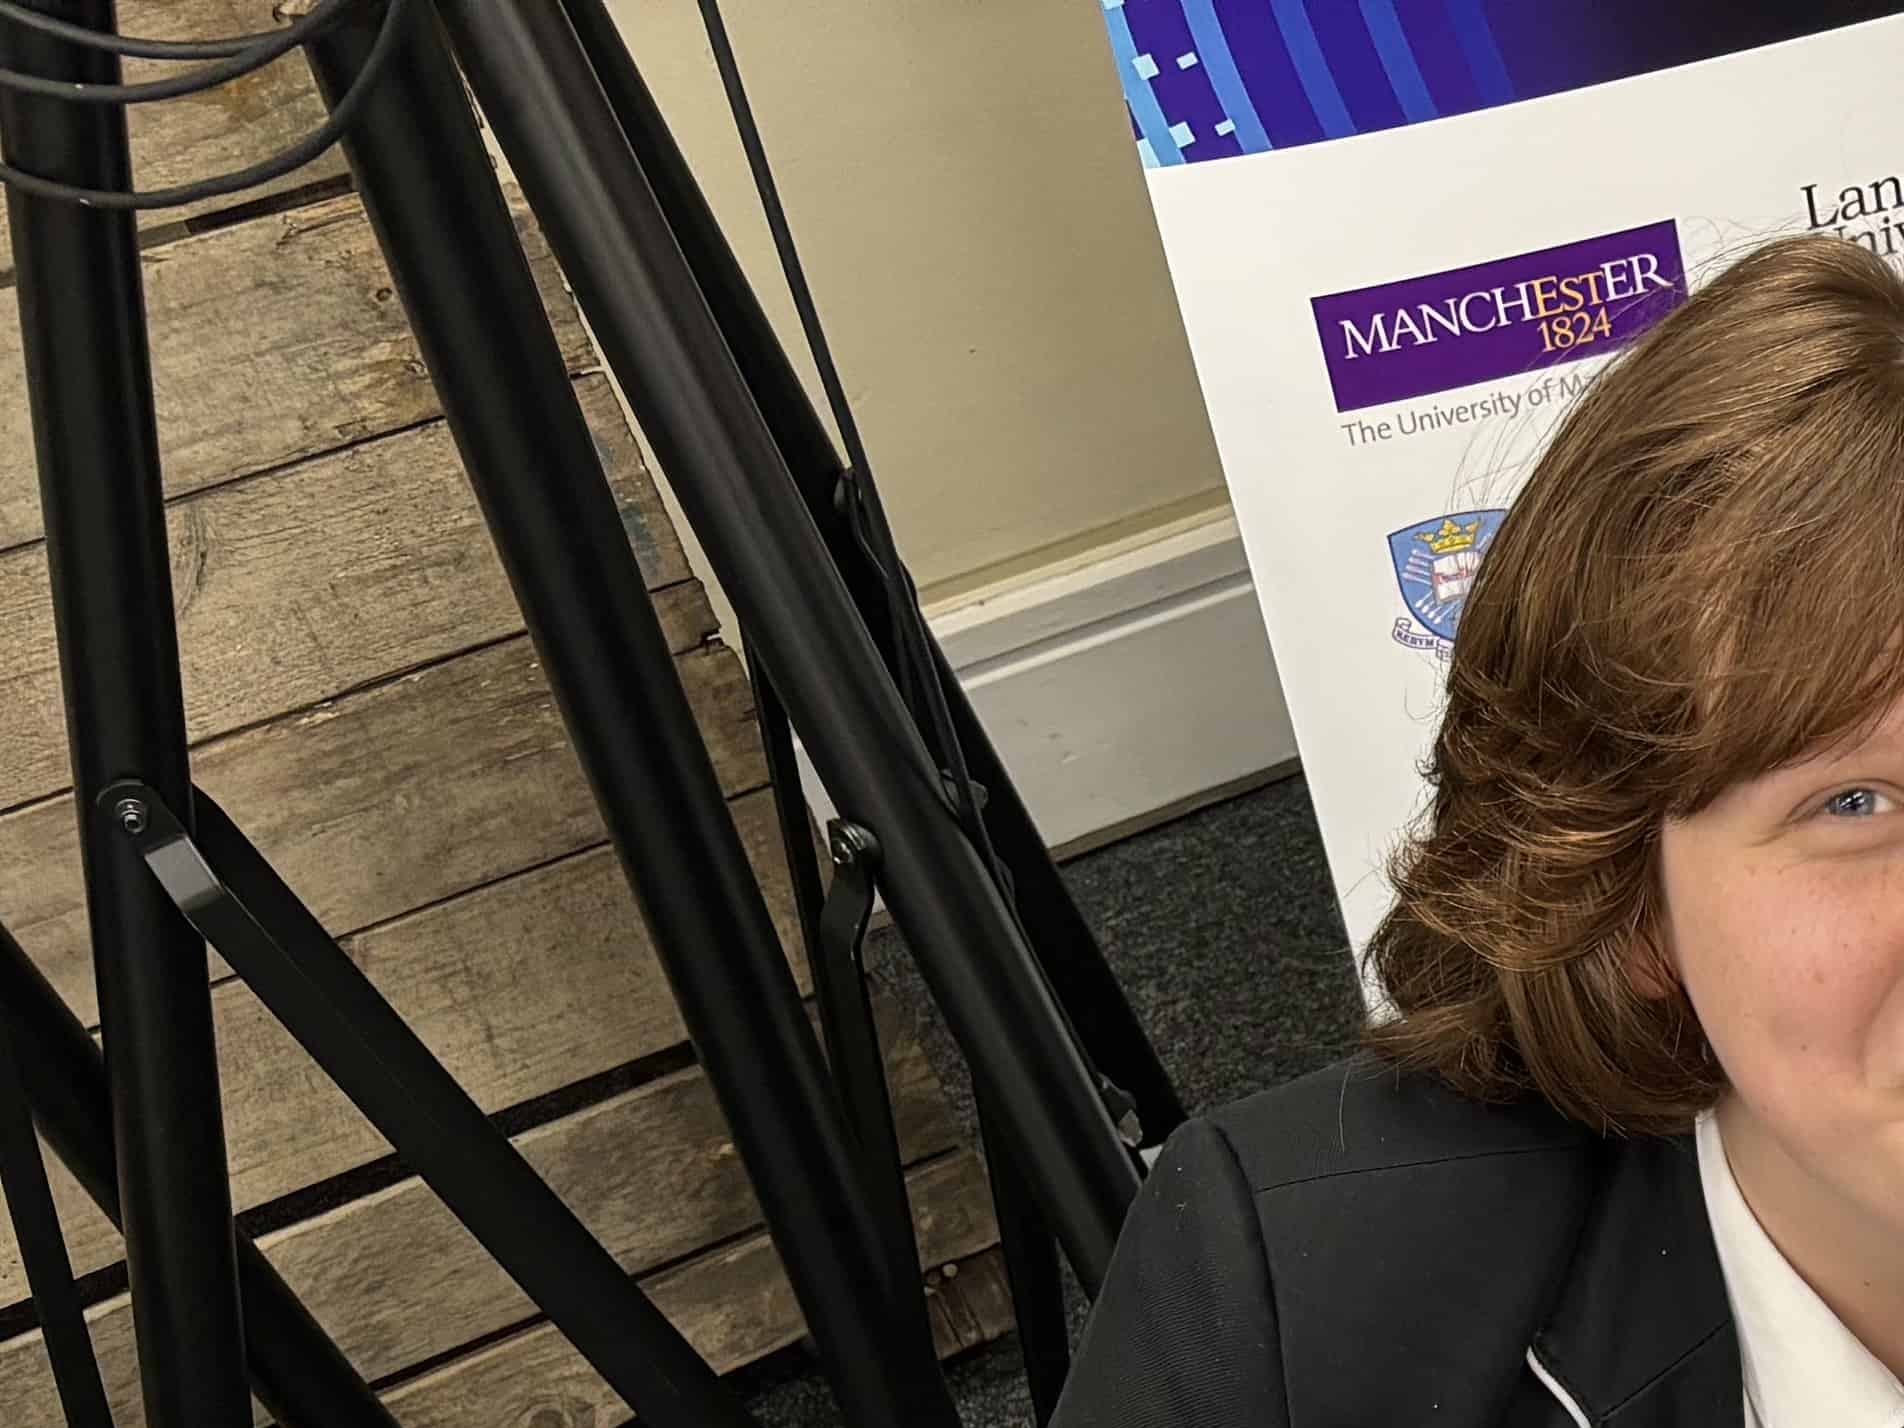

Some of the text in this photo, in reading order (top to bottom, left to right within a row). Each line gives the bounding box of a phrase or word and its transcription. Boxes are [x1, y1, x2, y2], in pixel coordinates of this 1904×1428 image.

[1339, 252, 1674, 360] MANCHESTER
[1537, 306, 1612, 354] 1824
[1341, 422, 1393, 447] The
[1397, 390, 1523, 438] University
[1527, 379, 1554, 409] of
